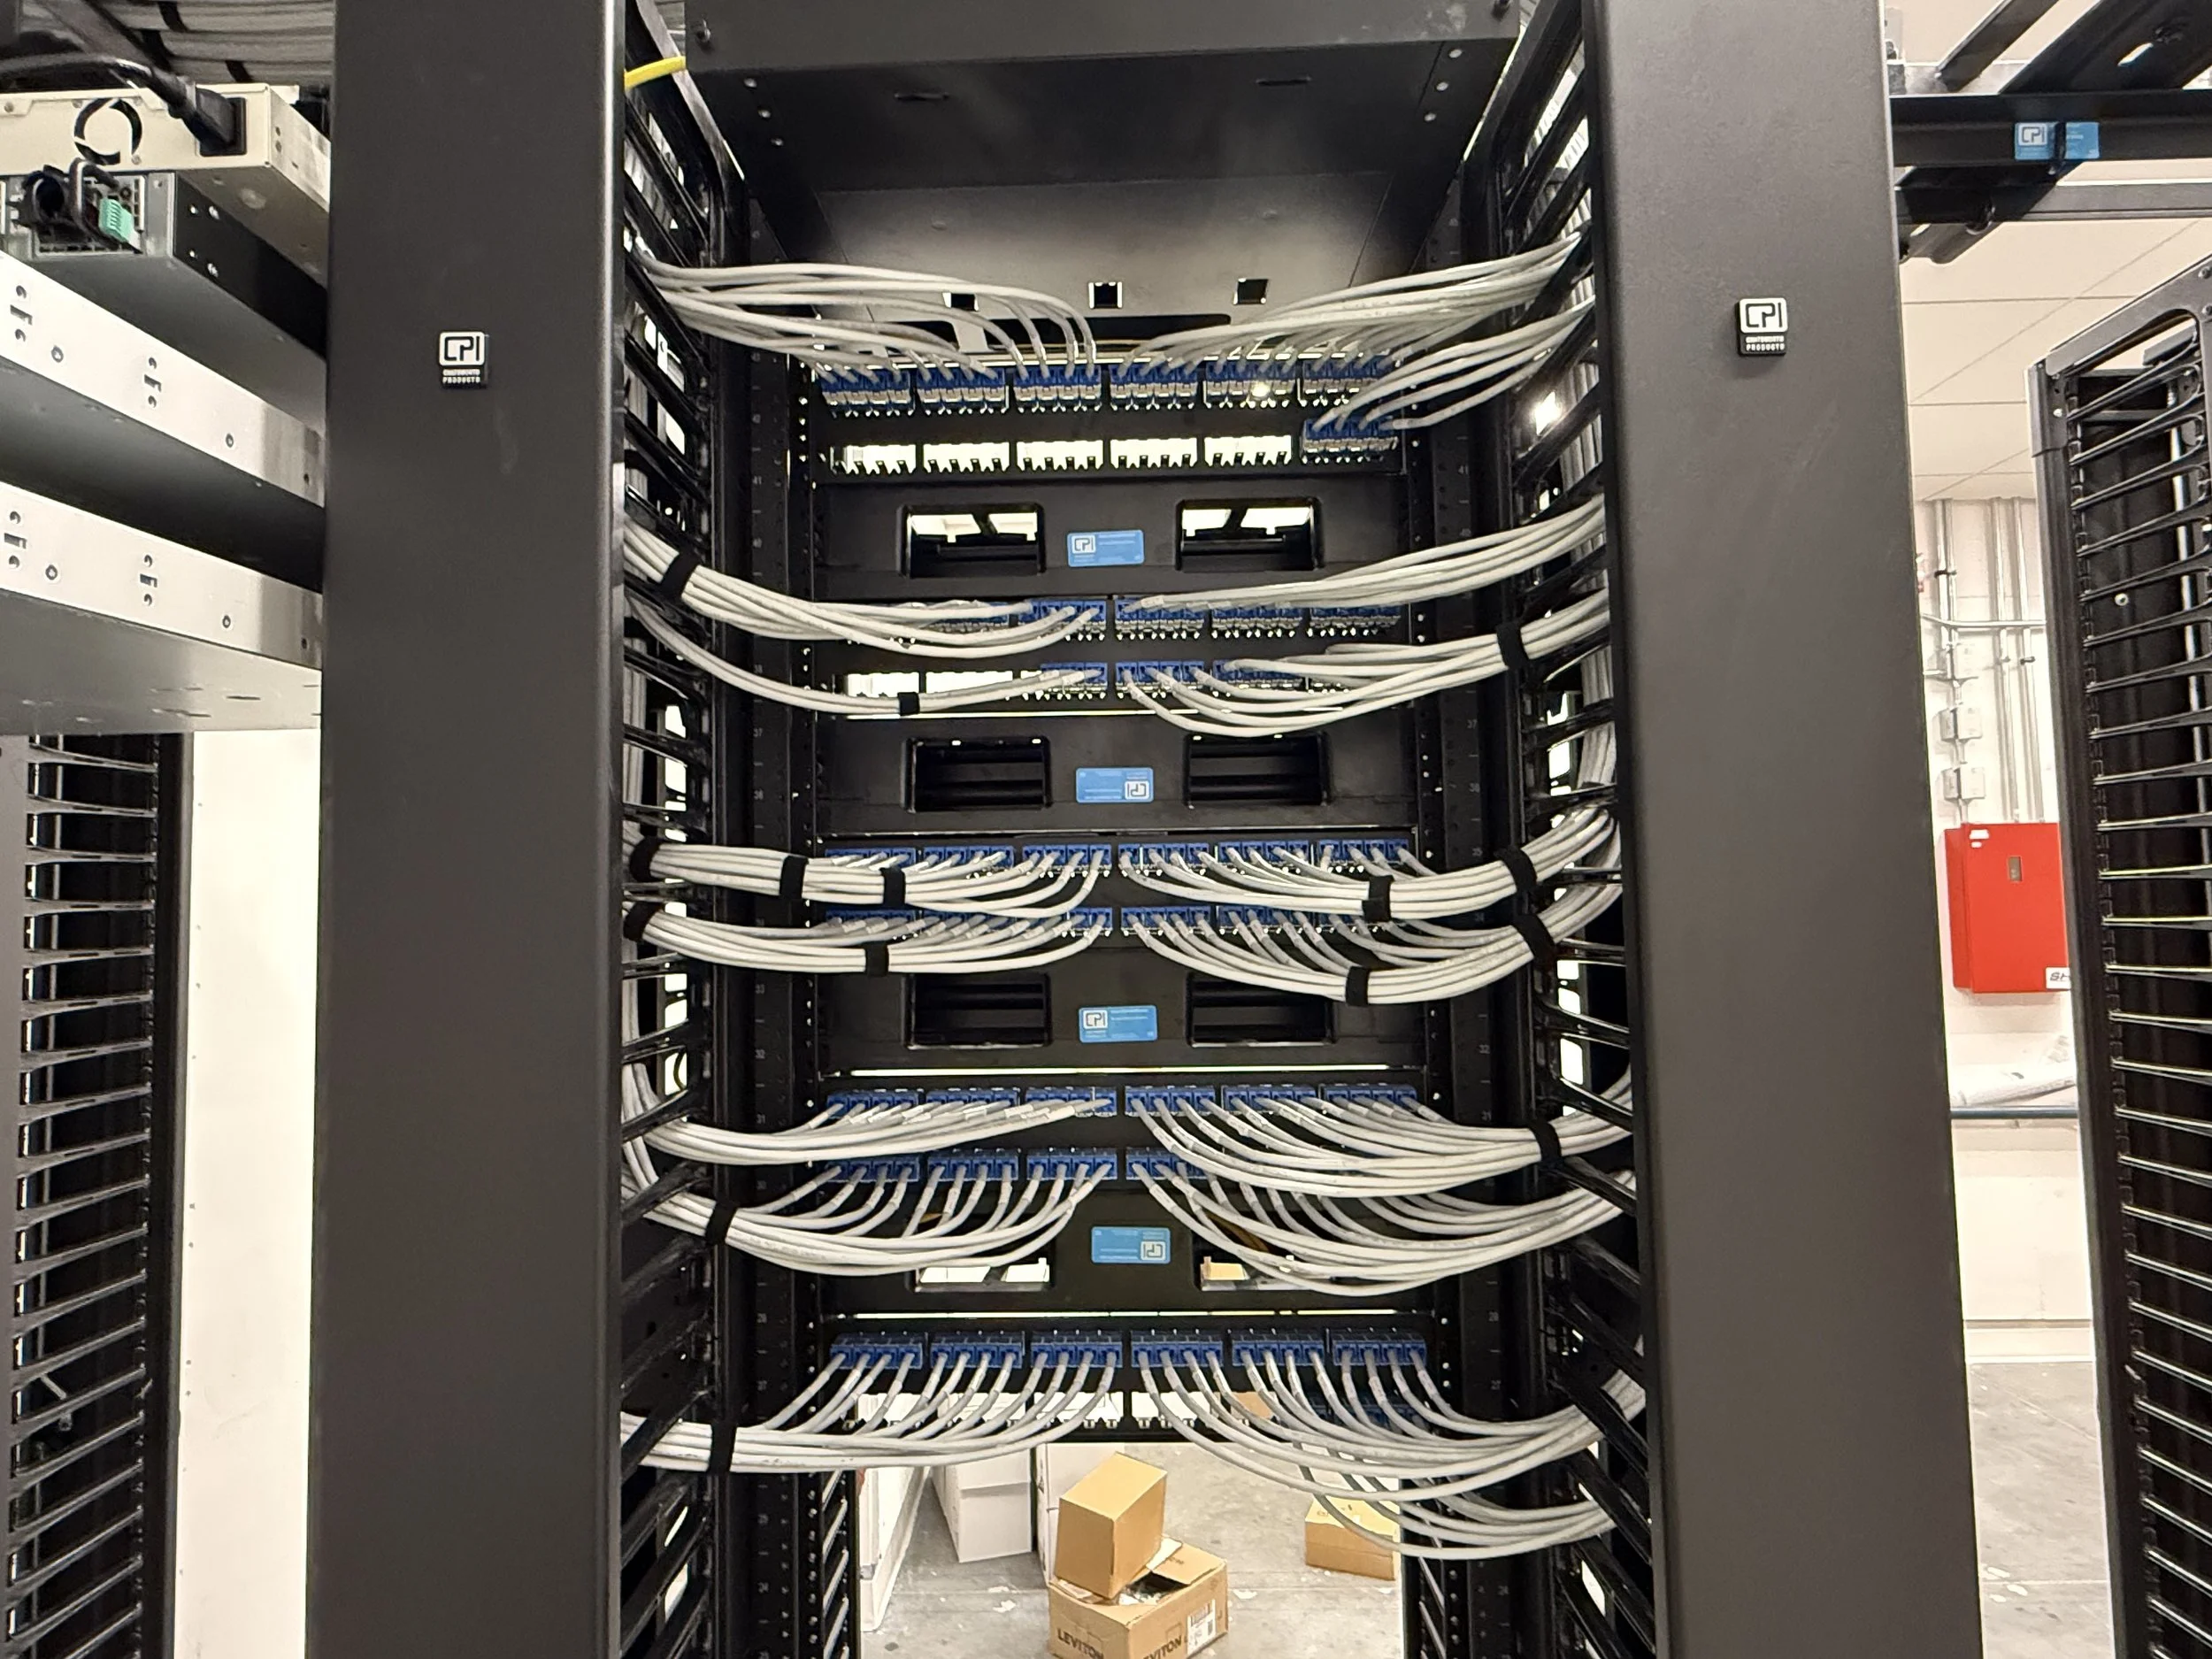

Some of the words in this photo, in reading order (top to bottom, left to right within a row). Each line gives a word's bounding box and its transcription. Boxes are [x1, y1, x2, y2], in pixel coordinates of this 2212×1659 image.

[1745, 302, 1784, 328] CPI
[444, 335, 480, 362] CPI
[1056, 1627, 1104, 1659] LEVITON
[1143, 1635, 1182, 1659] VITON
